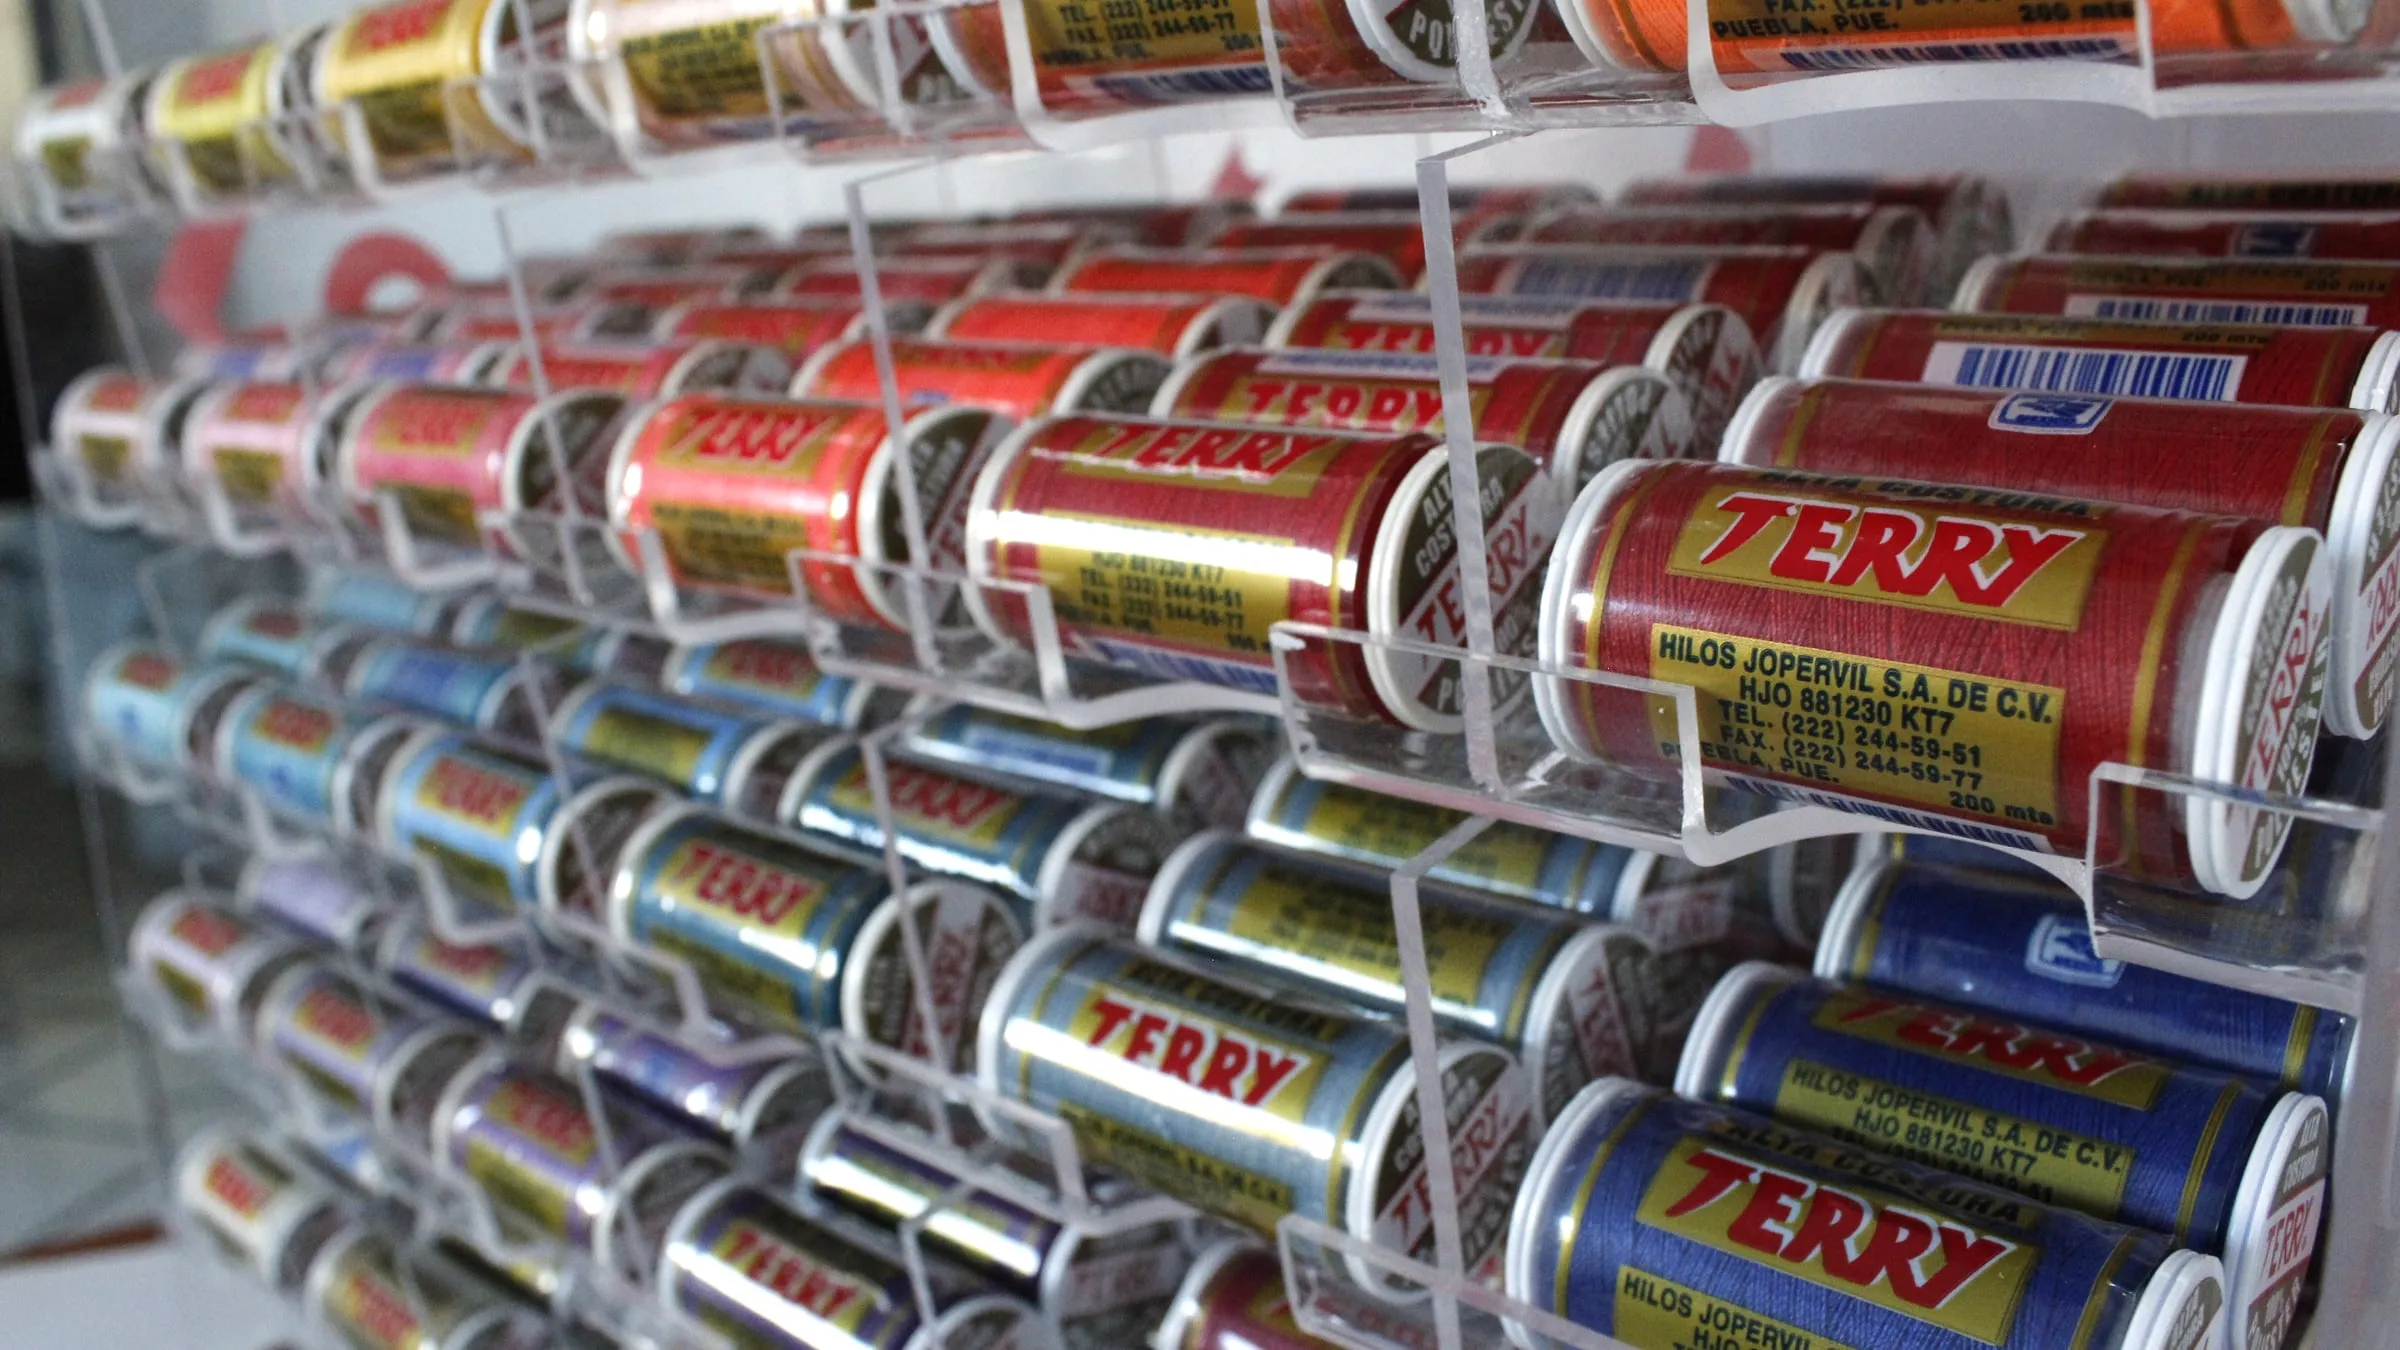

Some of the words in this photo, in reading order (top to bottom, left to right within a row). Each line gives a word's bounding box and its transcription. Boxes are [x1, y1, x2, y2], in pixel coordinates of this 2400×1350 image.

[1712, 16, 1829, 38] PUEBLA,
[1832, 12, 1899, 32] PUE.
[1096, 424, 1332, 484] TERRY
[1415, 476, 1505, 577] COSTRA
[1700, 491, 2086, 608] TERRY
[1658, 631, 1737, 670] HILOS
[1743, 647, 1875, 693] JOPERVIL
[1883, 667, 1939, 704] S.A.
[1947, 678, 1990, 713] DE
[1996, 687, 2054, 725] C.V.
[1739, 675, 1792, 709] HJO
[1800, 687, 1893, 727] 881230
[1901, 703, 1956, 738] KT7
[1718, 698, 1774, 729] TEL.
[1782, 711, 1845, 746] (222)
[1854, 725, 1982, 769] 244-59-51
[1719, 724, 1776, 752] FAX.
[1783, 737, 1847, 769] (222)
[1854, 751, 1983, 792] 244-59-77
[1779, 757, 1840, 784] PUE.
[1948, 790, 1997, 815] 200
[1087, 992, 1308, 1108] TERRY
[1839, 1000, 2157, 1087] TERRY
[1792, 1062, 1860, 1101] HILOS
[1863, 1083, 1974, 1133] JOPERVIL
[1981, 1115, 2027, 1148] S.A.
[2035, 1129, 2072, 1160] DE
[2076, 1141, 2121, 1174] C.V.
[1853, 1106, 1900, 1138] HJO
[1905, 1121, 1986, 1163] 881230
[1990, 1145, 2037, 1177] KT7
[1666, 1148, 2018, 1309] TERRY
[1624, 1273, 1693, 1318] HILOS
